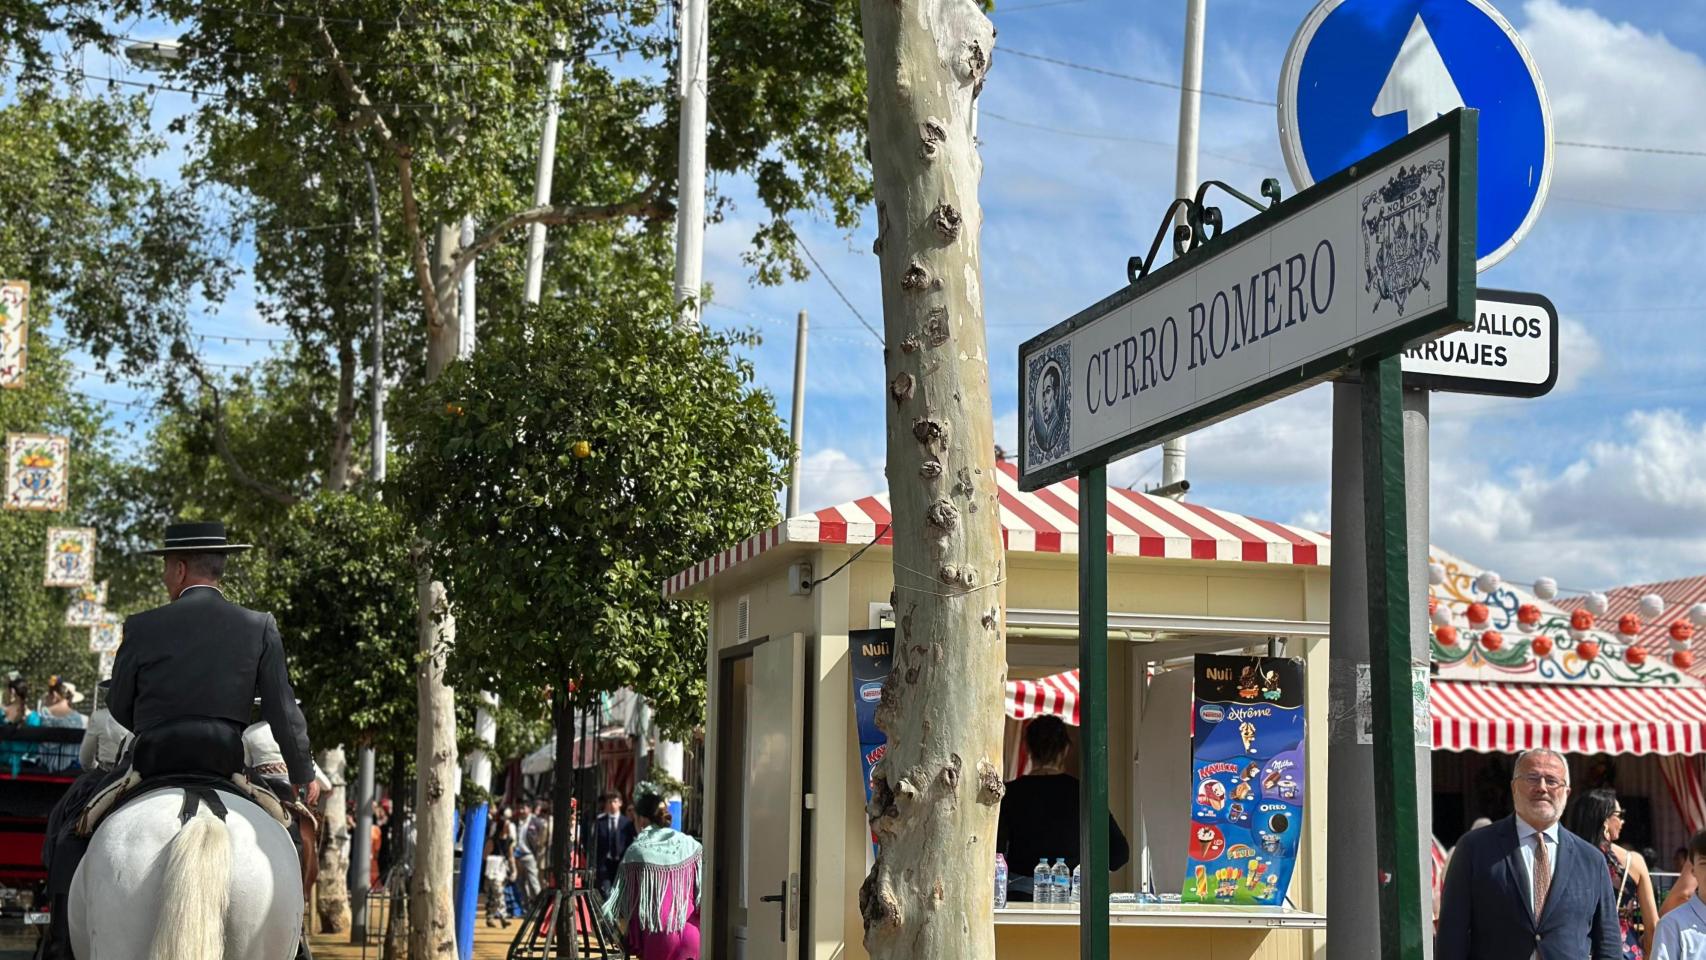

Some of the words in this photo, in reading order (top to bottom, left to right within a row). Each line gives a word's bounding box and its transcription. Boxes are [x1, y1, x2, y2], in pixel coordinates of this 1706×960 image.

[1086, 316, 1179, 415] CURRO
[1187, 239, 1336, 372] ROMERO
[1206, 667, 1233, 681] Nuii
[1260, 804, 1287, 812] OREO
